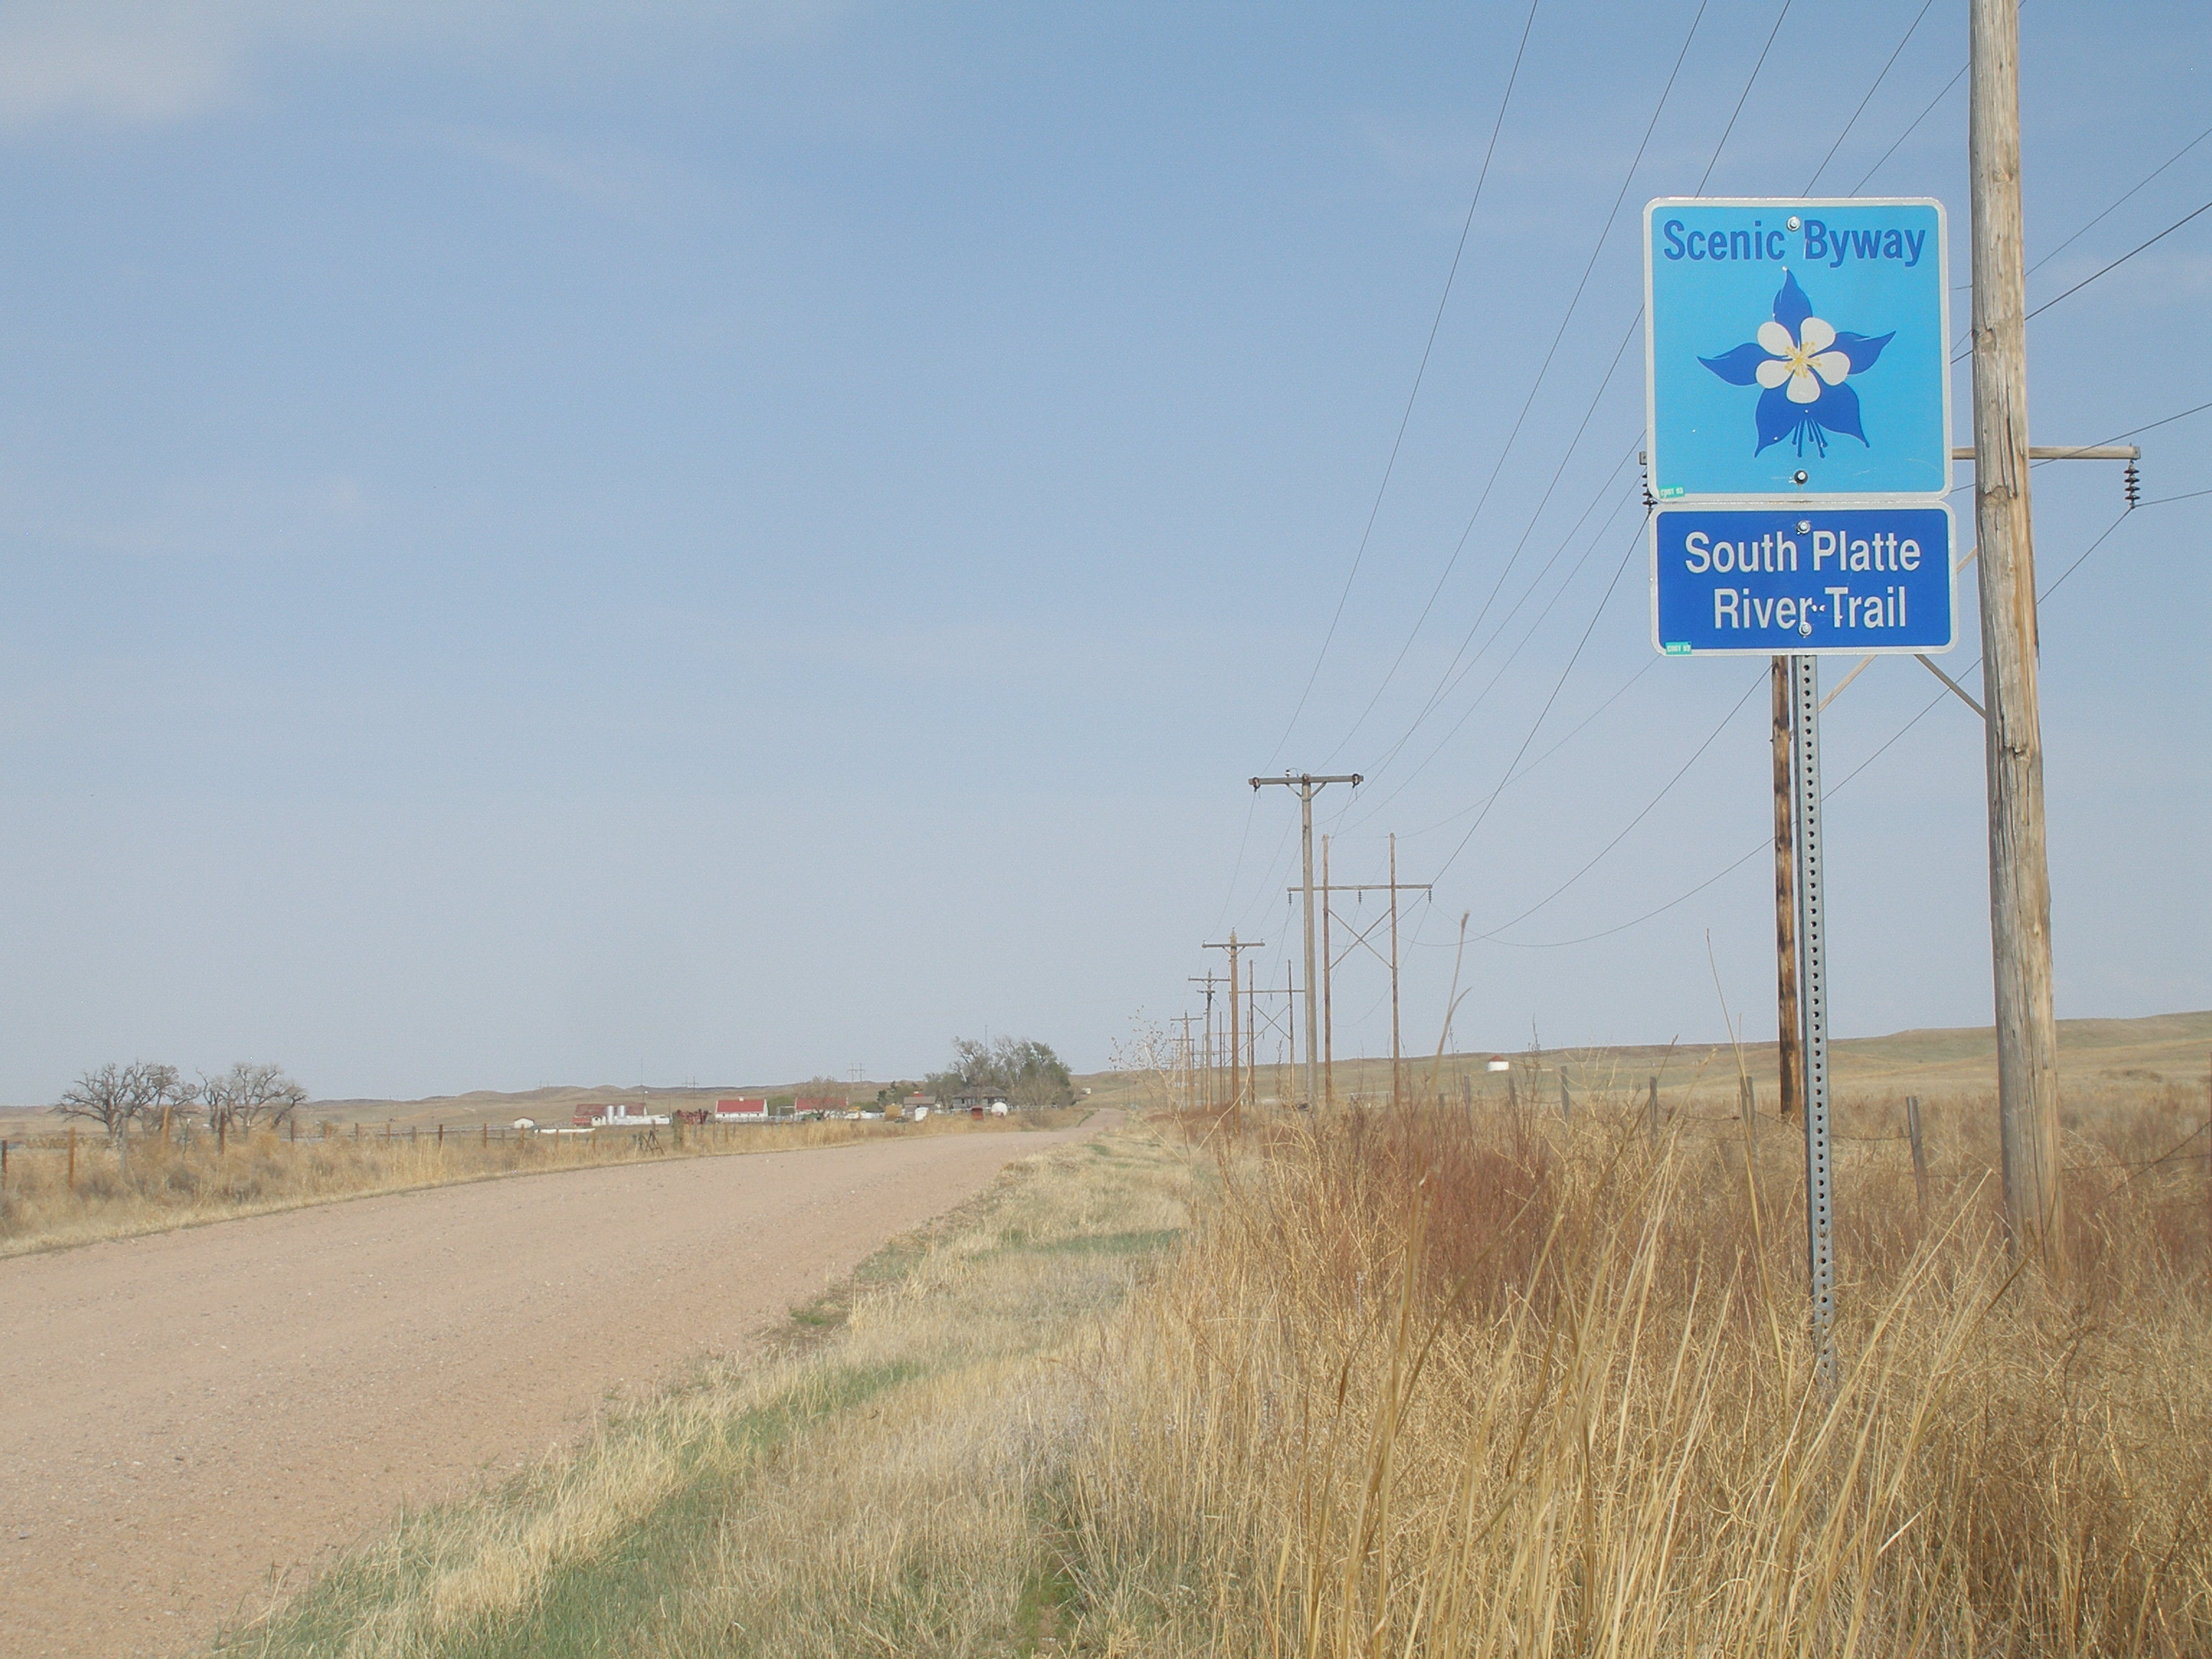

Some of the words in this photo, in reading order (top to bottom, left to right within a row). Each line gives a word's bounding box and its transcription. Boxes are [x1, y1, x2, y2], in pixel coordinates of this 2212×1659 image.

[1663, 220, 1785, 261] Scenic
[1804, 220, 1925, 268] Byway
[1685, 531, 1797, 573] South
[1813, 530, 1921, 572] Platte
[1714, 587, 1813, 629] River
[1825, 586, 1907, 629] Trail
